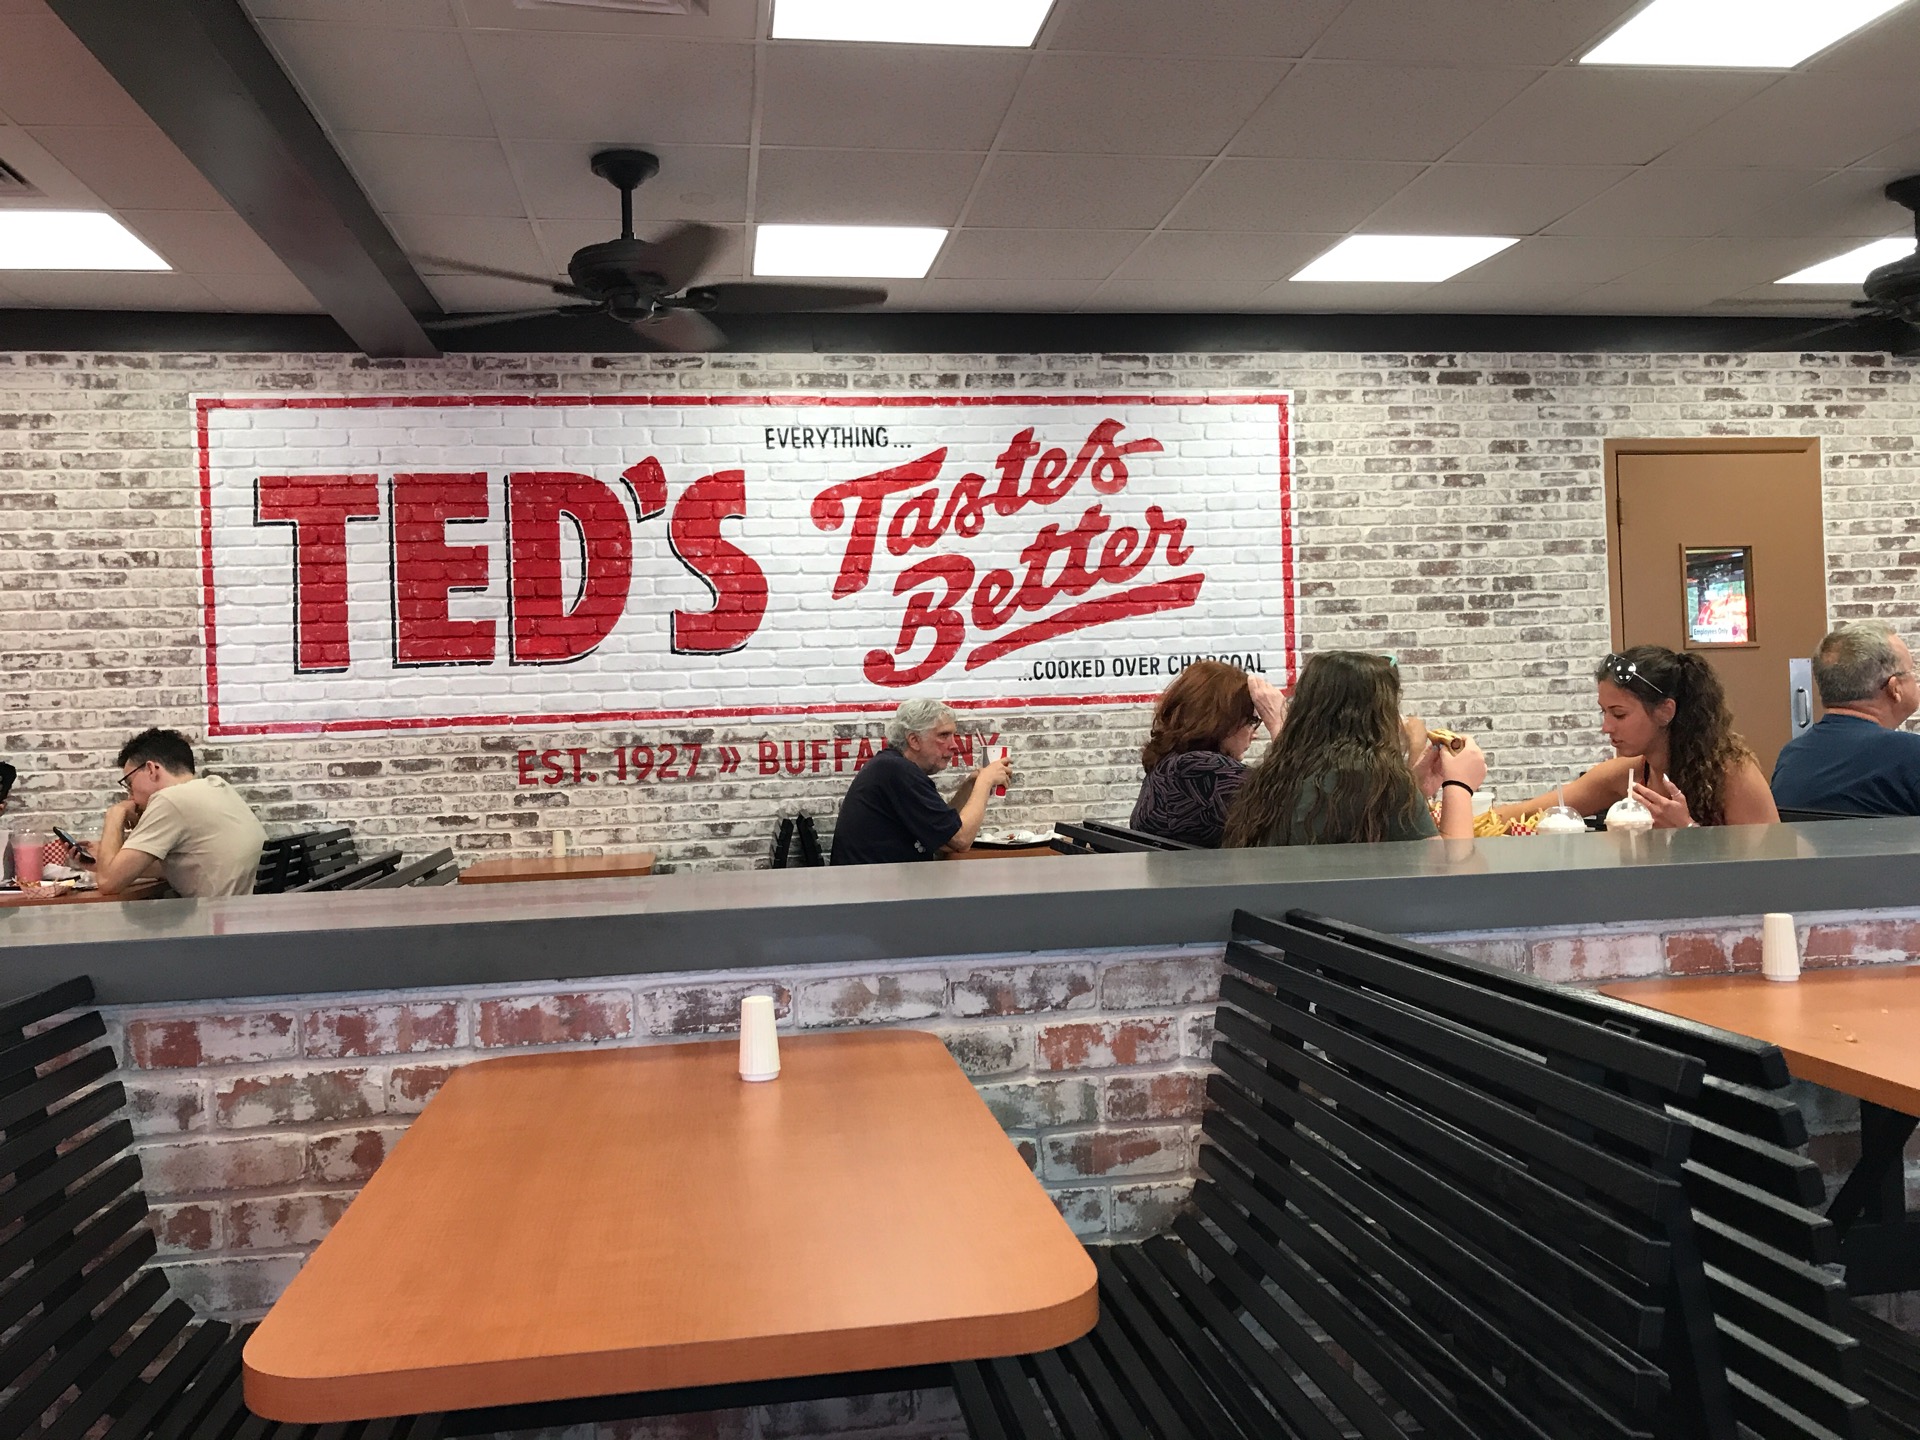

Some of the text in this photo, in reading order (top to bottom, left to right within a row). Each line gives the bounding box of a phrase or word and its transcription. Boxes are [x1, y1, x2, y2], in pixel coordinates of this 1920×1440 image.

[765, 427, 911, 450] EVERYTHING...
[810, 418, 1165, 600] Tastes
[252, 456, 769, 674] TED'S
[862, 504, 1194, 688] Better
[1694, 628, 1717, 637] Employees
[1113, 657, 1160, 677] OVER
[1168, 653, 1266, 675] CHOAL
[518, 747, 598, 785] EST.
[613, 743, 702, 781] 1927
